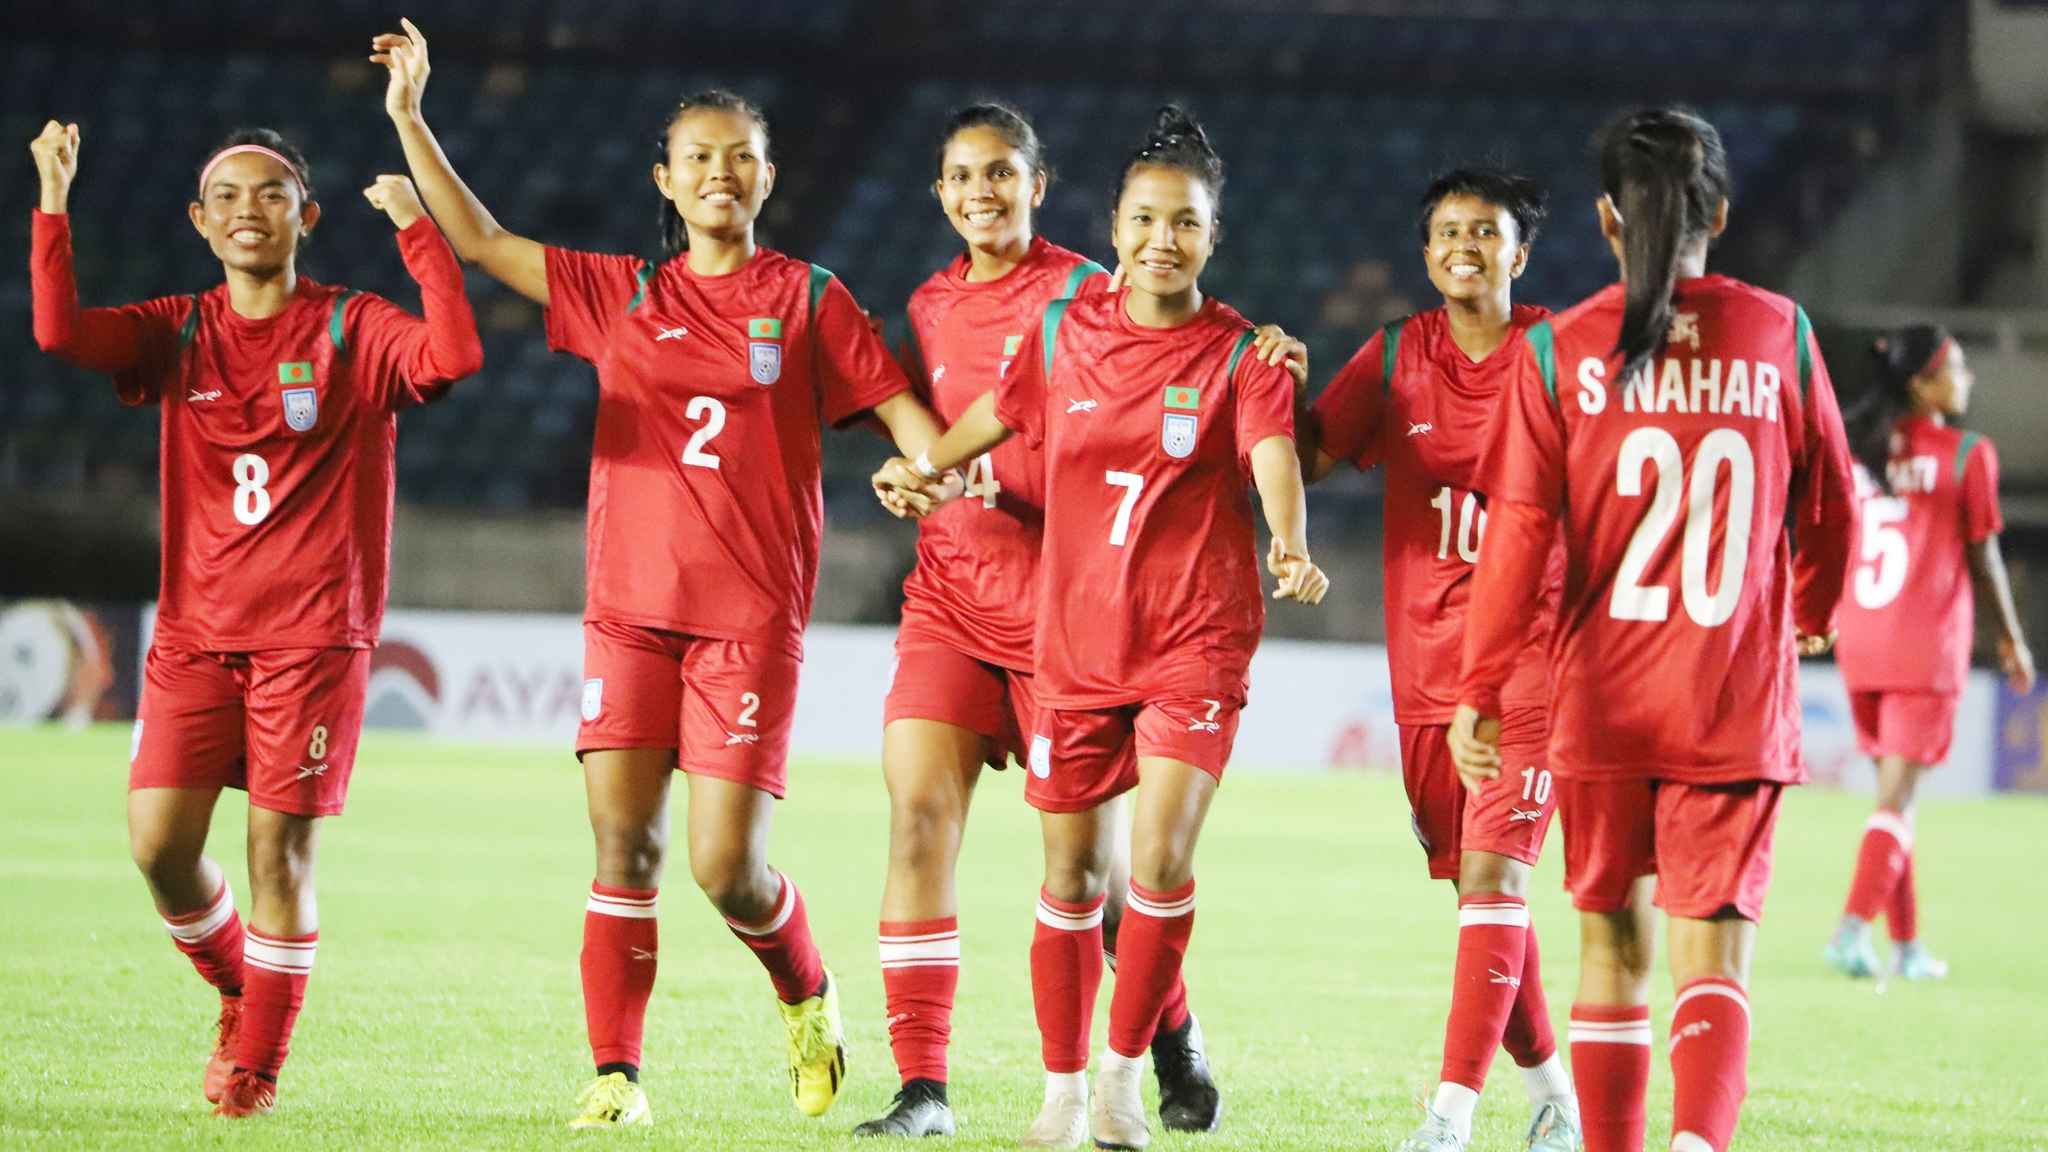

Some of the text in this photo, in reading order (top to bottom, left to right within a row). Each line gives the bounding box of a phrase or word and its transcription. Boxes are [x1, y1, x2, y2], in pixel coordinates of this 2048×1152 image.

[1577, 358, 1780, 422] S NAHAR
[683, 396, 726, 468] 2
[232, 453, 271, 526] 8
[965, 452, 1001, 509] 4
[1105, 471, 1144, 546] 7
[1431, 487, 1486, 562] 10
[1609, 428, 1755, 627] 20
[1855, 497, 1909, 609] 5
[310, 725, 328, 760] 8
[738, 693, 759, 727] 2
[1204, 700, 1220, 721] 7
[1521, 767, 1551, 804] 10
